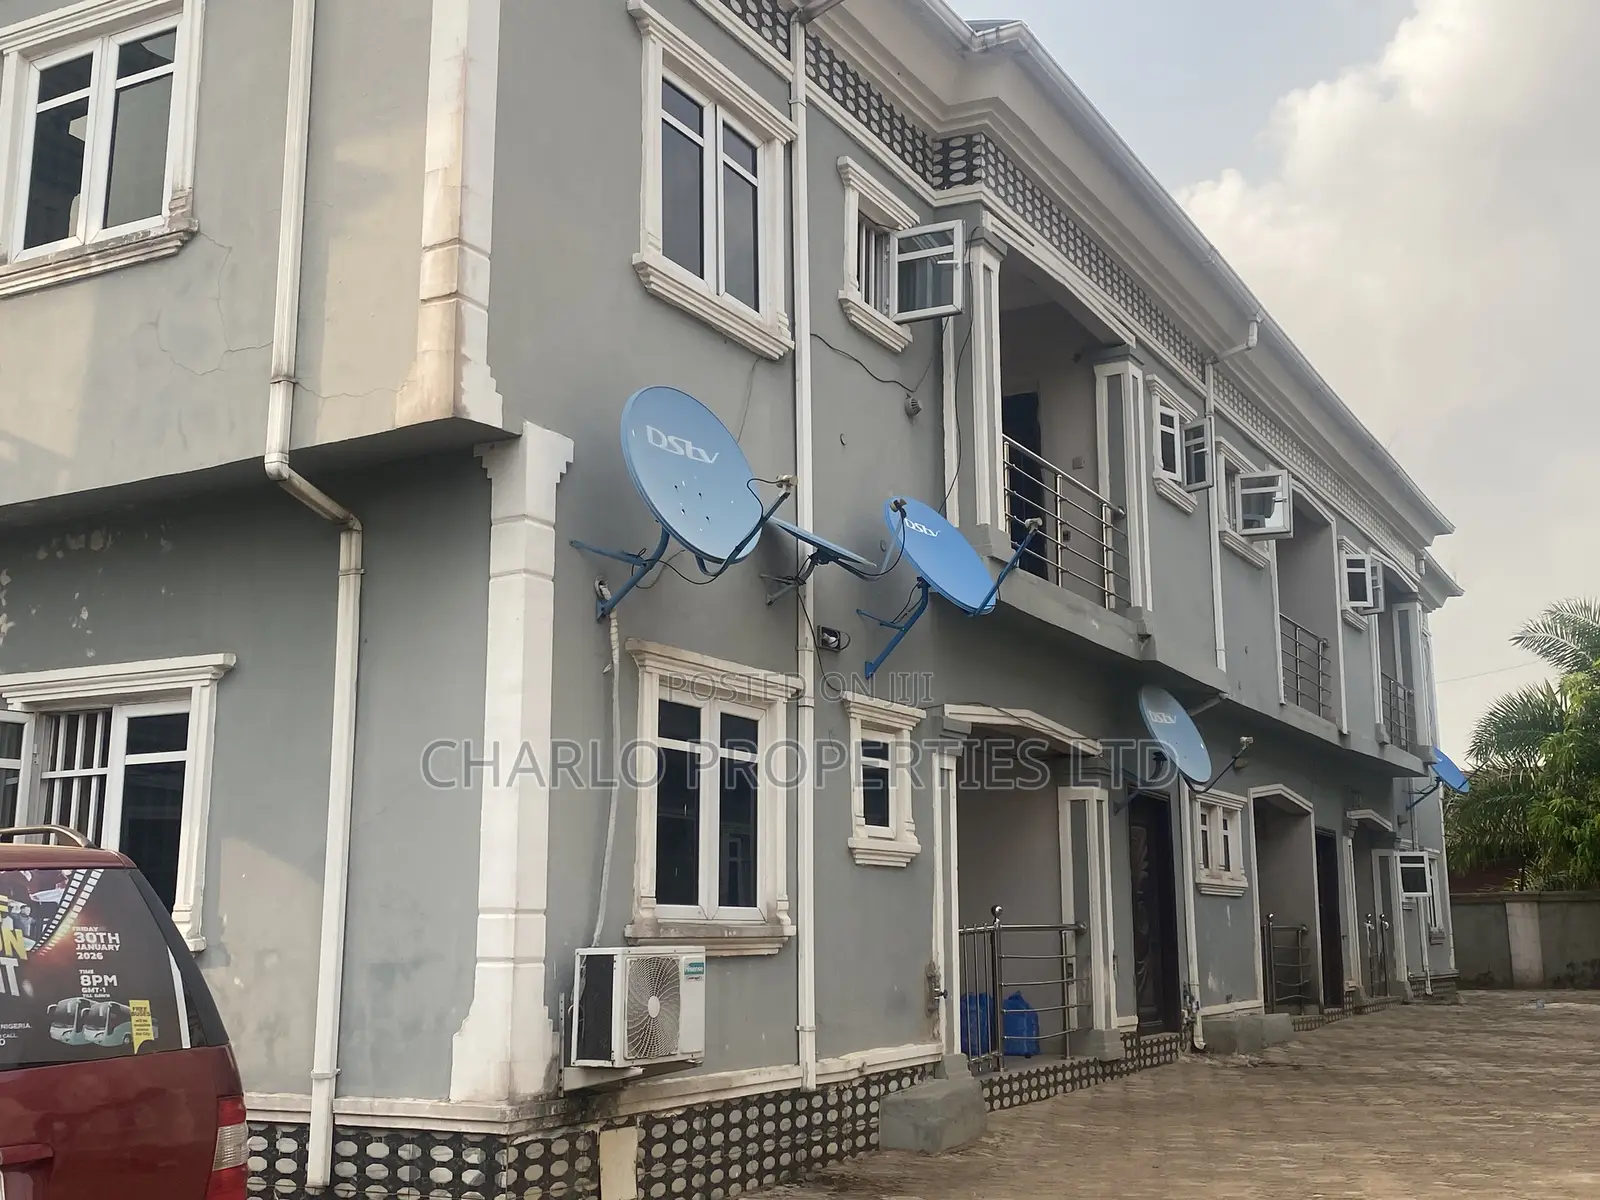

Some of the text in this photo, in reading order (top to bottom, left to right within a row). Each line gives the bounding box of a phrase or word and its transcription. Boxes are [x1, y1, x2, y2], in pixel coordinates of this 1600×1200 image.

[74, 932, 120, 944] 30TH
[76, 943, 120, 951] JANUARY
[76, 952, 104, 960] 2026
[80, 975, 118, 987] 8PM
